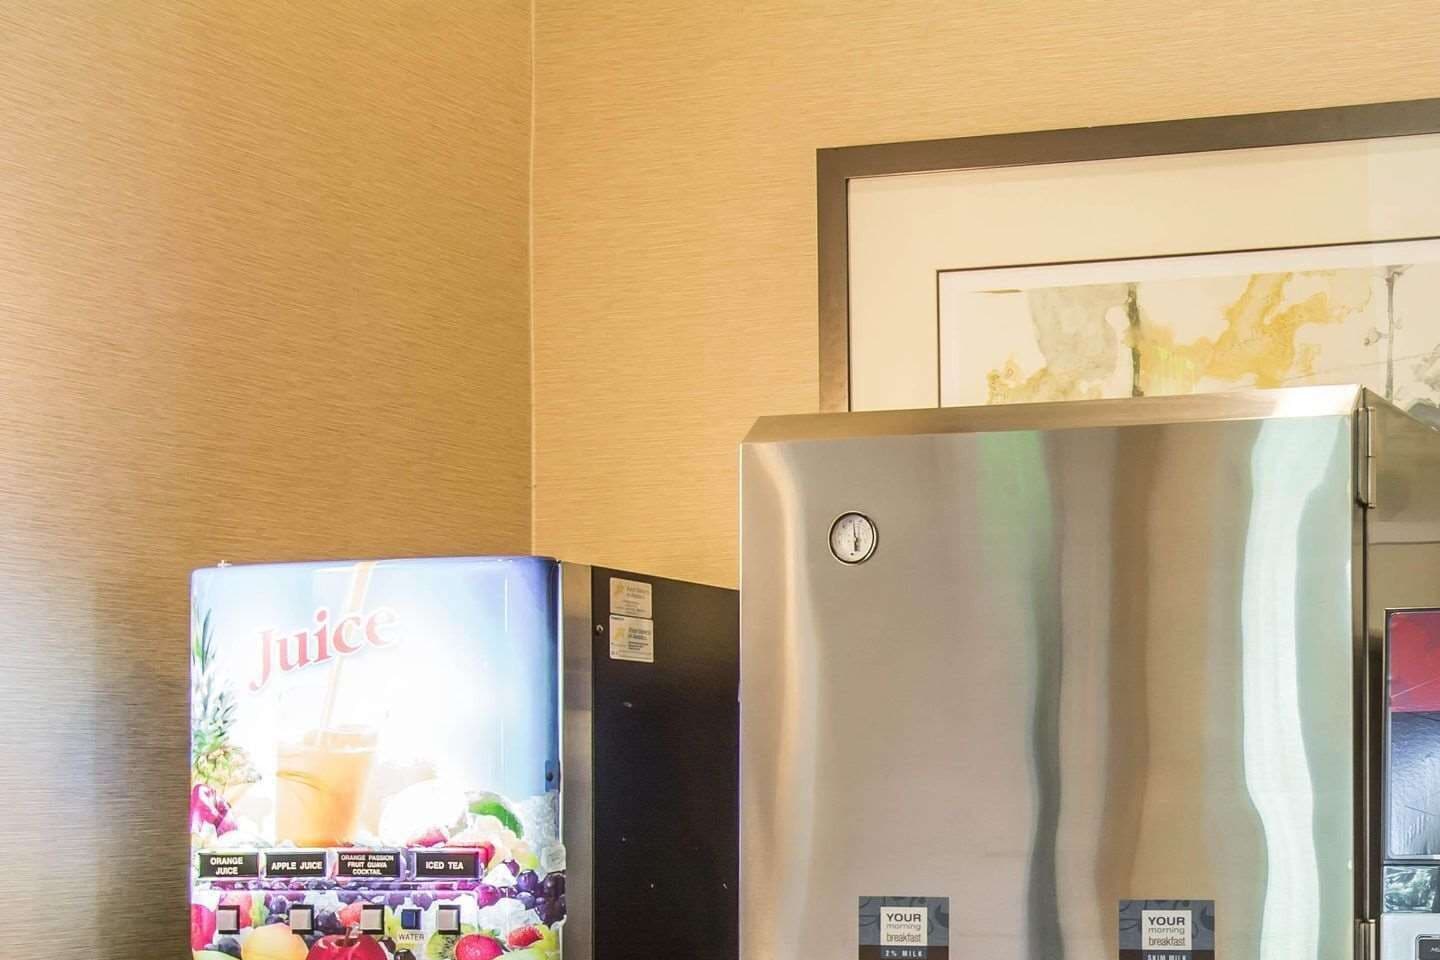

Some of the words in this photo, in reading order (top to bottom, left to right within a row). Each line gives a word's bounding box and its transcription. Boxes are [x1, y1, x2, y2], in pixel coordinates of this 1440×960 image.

[249, 609, 397, 692] Juice
[210, 857, 243, 865] ORANGE
[271, 862, 297, 870] APPLE
[299, 861, 322, 870] JUICE
[425, 862, 444, 870] ICED
[447, 862, 464, 870] TEA
[215, 867, 238, 875] JUICE
[886, 913, 921, 922] YOUR
[1148, 916, 1185, 926] YOUR
[1148, 926, 1185, 935] morning
[399, 933, 424, 941] WATER
[886, 932, 921, 943] breakfast
[1148, 936, 1185, 946] breakfast
